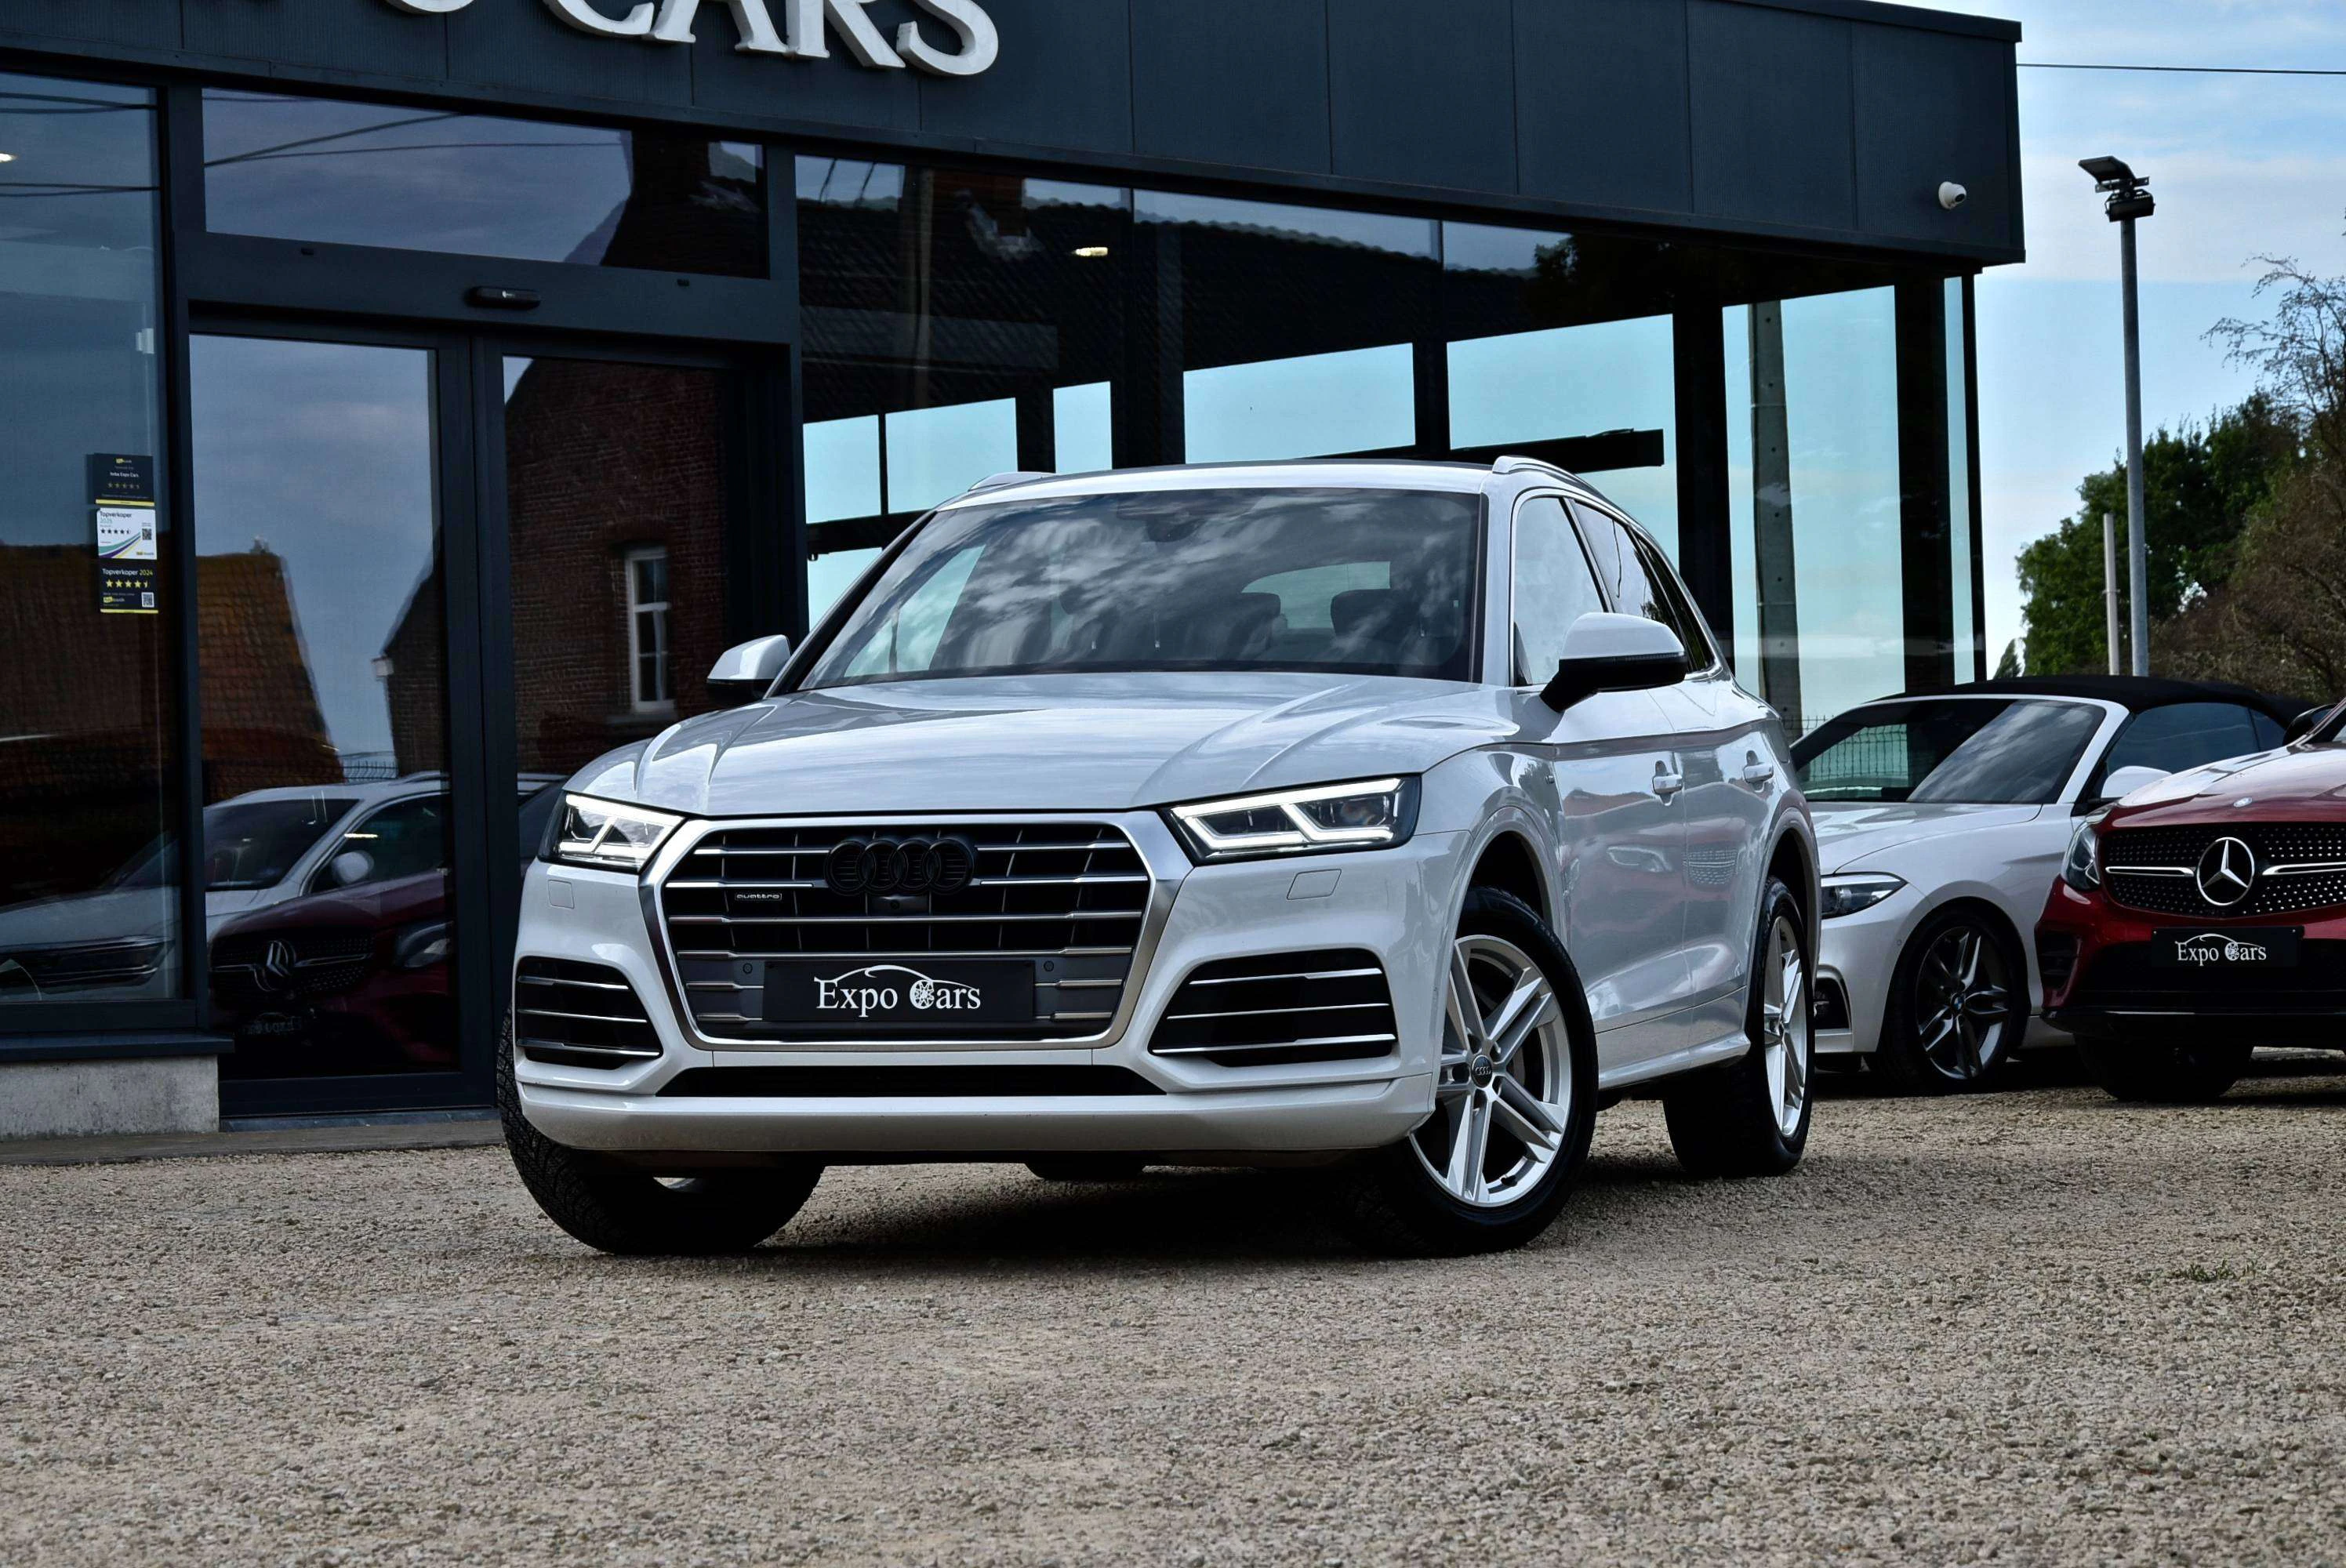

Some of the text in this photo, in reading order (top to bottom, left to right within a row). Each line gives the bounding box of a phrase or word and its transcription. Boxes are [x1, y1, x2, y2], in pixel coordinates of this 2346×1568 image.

[2176, 942, 2267, 966] Expo Cars
[815, 978, 982, 1018] Expo Cars
